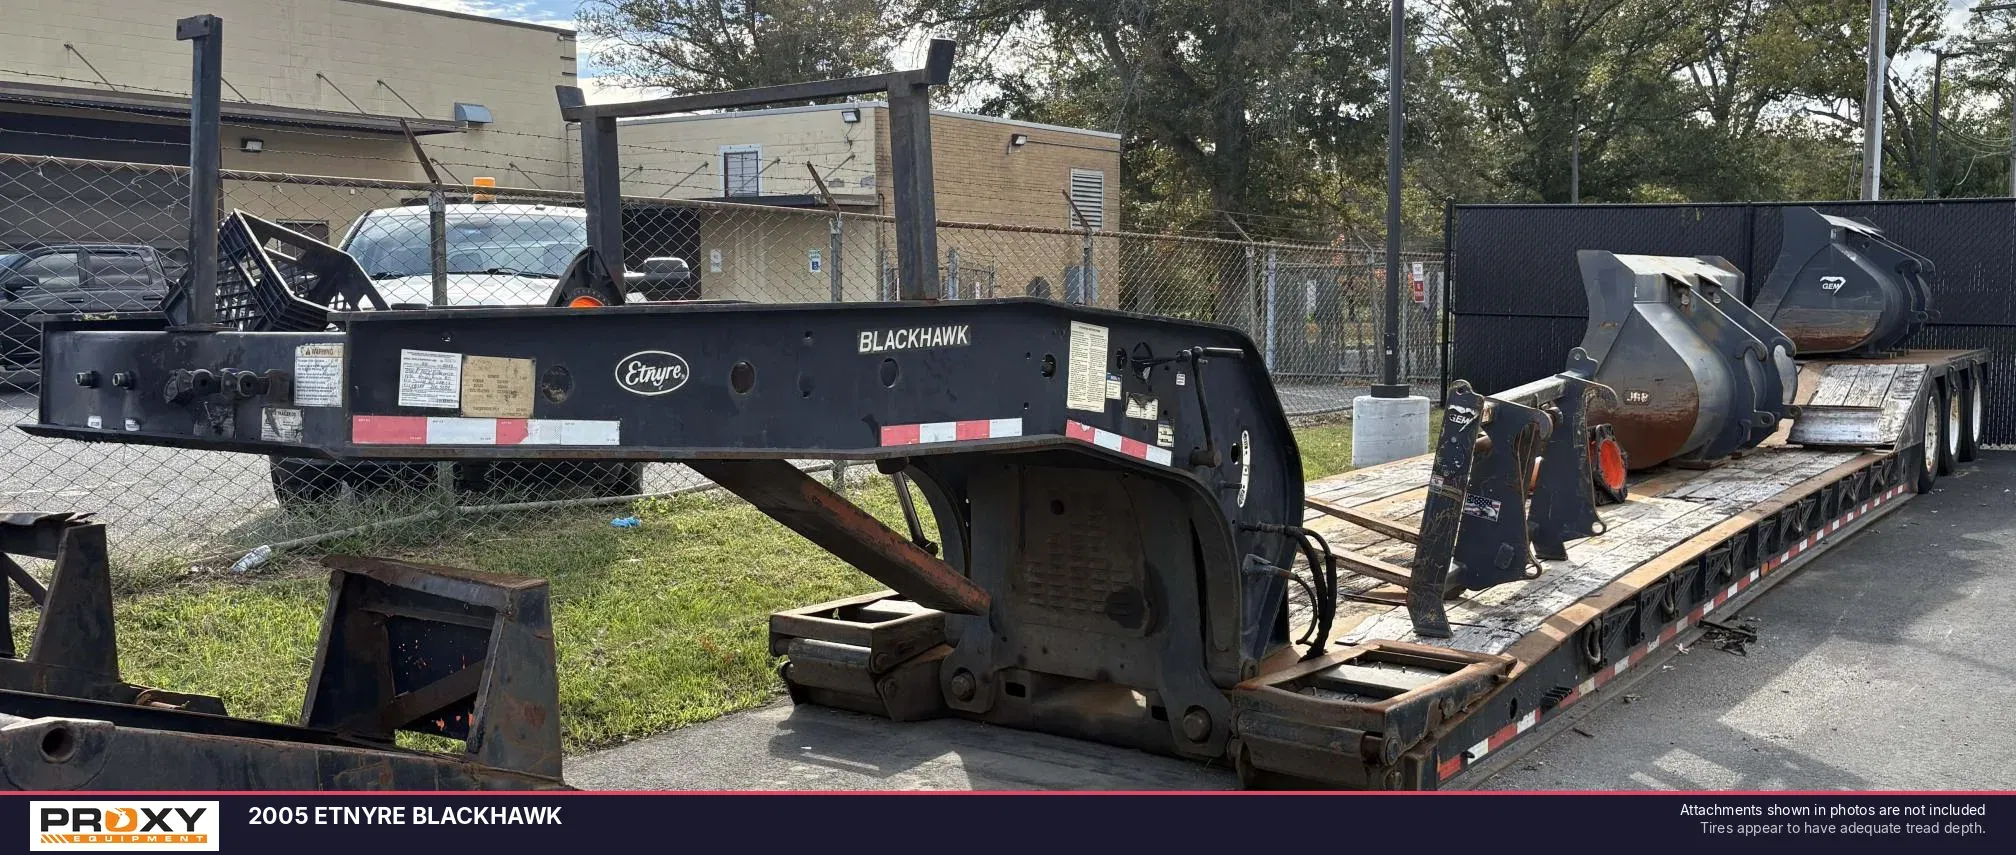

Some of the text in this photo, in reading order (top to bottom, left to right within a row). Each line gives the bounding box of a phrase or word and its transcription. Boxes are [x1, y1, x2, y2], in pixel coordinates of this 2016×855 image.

[859, 325, 968, 352] BLACKHAWK
[625, 360, 682, 390] Etnyre
[1448, 413, 1472, 425] GEM
